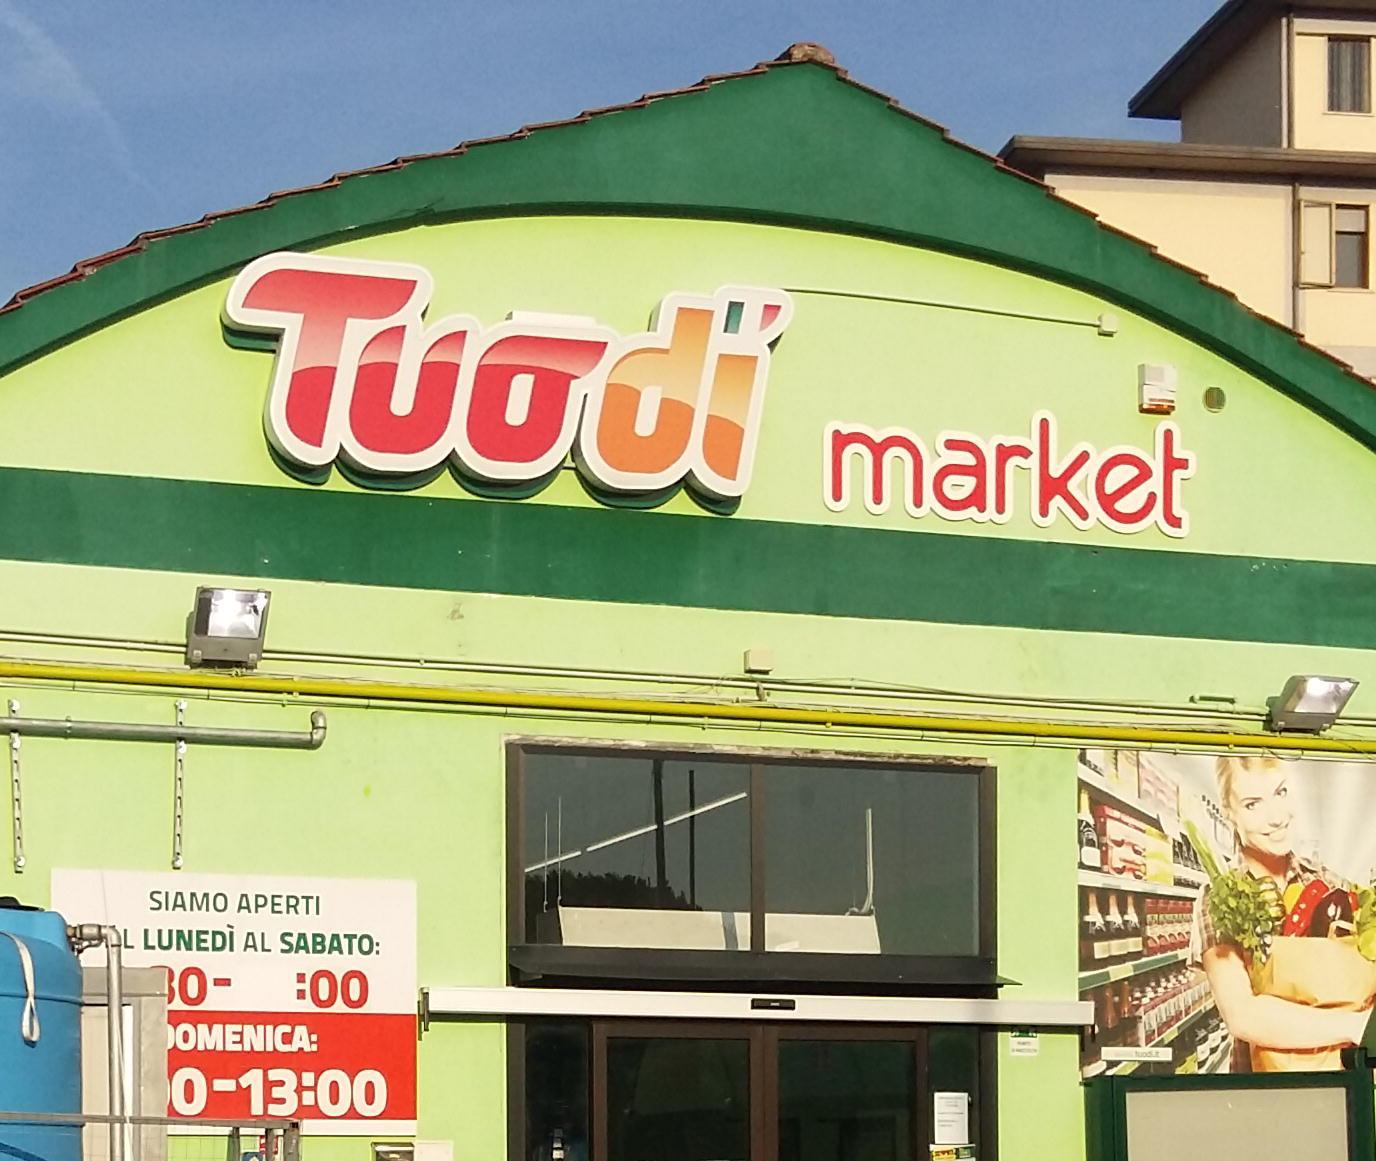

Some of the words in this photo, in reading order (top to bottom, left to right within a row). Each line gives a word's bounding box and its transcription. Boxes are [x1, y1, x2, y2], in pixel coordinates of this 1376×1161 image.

[831, 417, 1189, 529] market
[149, 890, 228, 913] SIAMO
[237, 893, 320, 915] APERTI
[143, 923, 235, 953] LUNEDÌ
[243, 931, 272, 953] AL
[280, 931, 380, 956] SABATO:
[167, 1066, 388, 1118] 0-13:00
